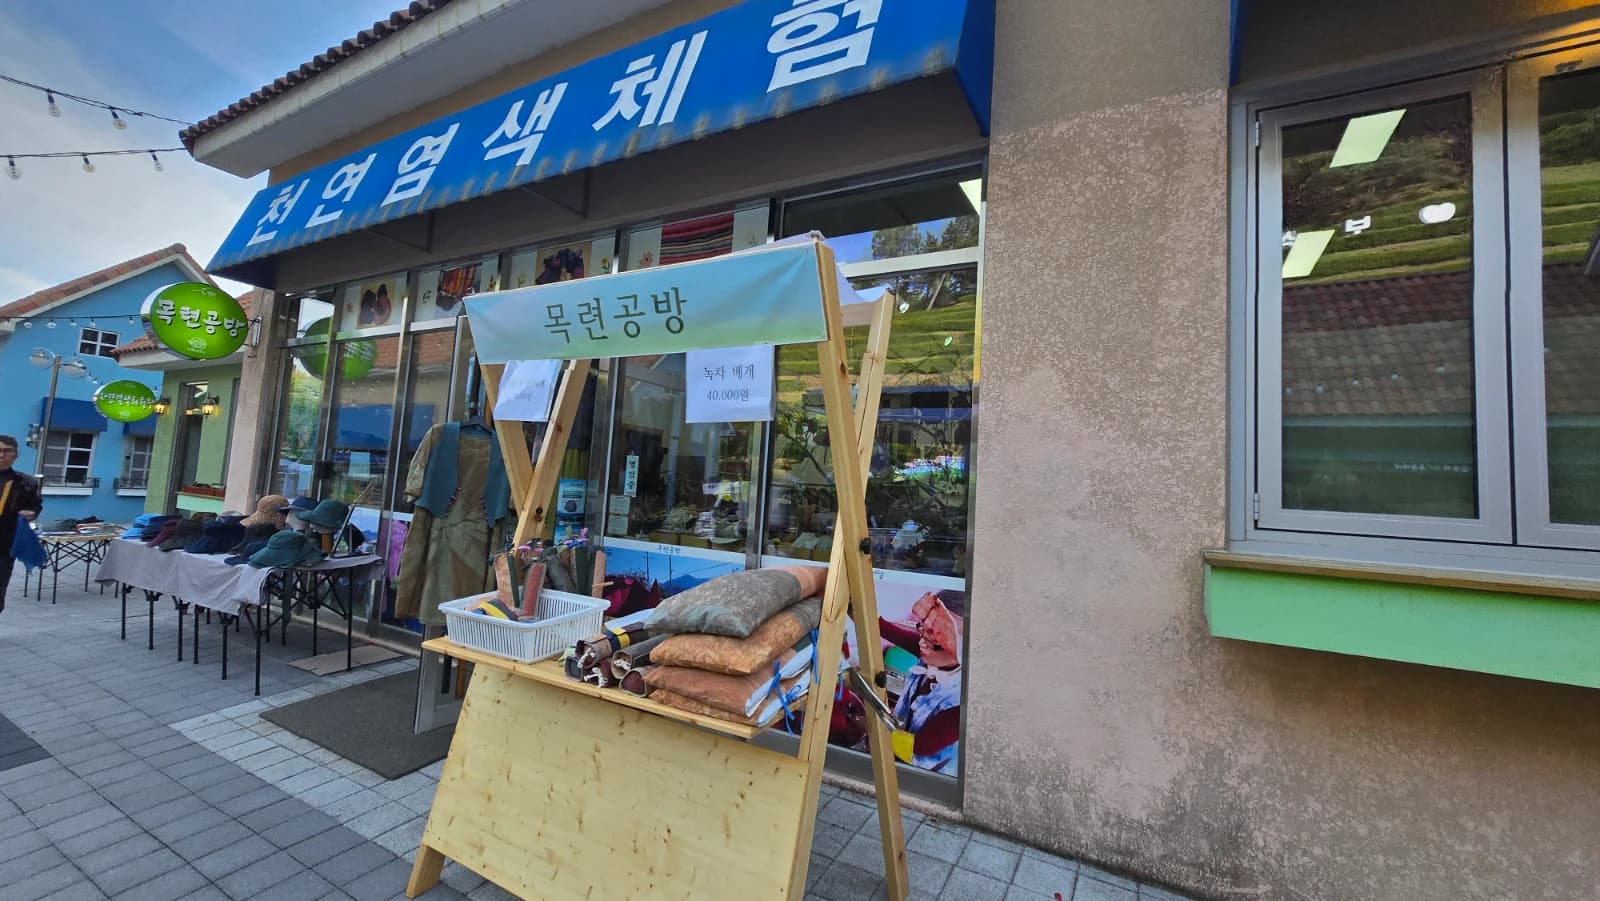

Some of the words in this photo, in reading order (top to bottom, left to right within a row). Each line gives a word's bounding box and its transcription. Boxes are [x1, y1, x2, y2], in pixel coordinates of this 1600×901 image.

[156, 299, 247, 338] 목련공방
[543, 286, 688, 343] 목련공방
[703, 365, 726, 381] 녹차
[732, 364, 755, 380] 베개
